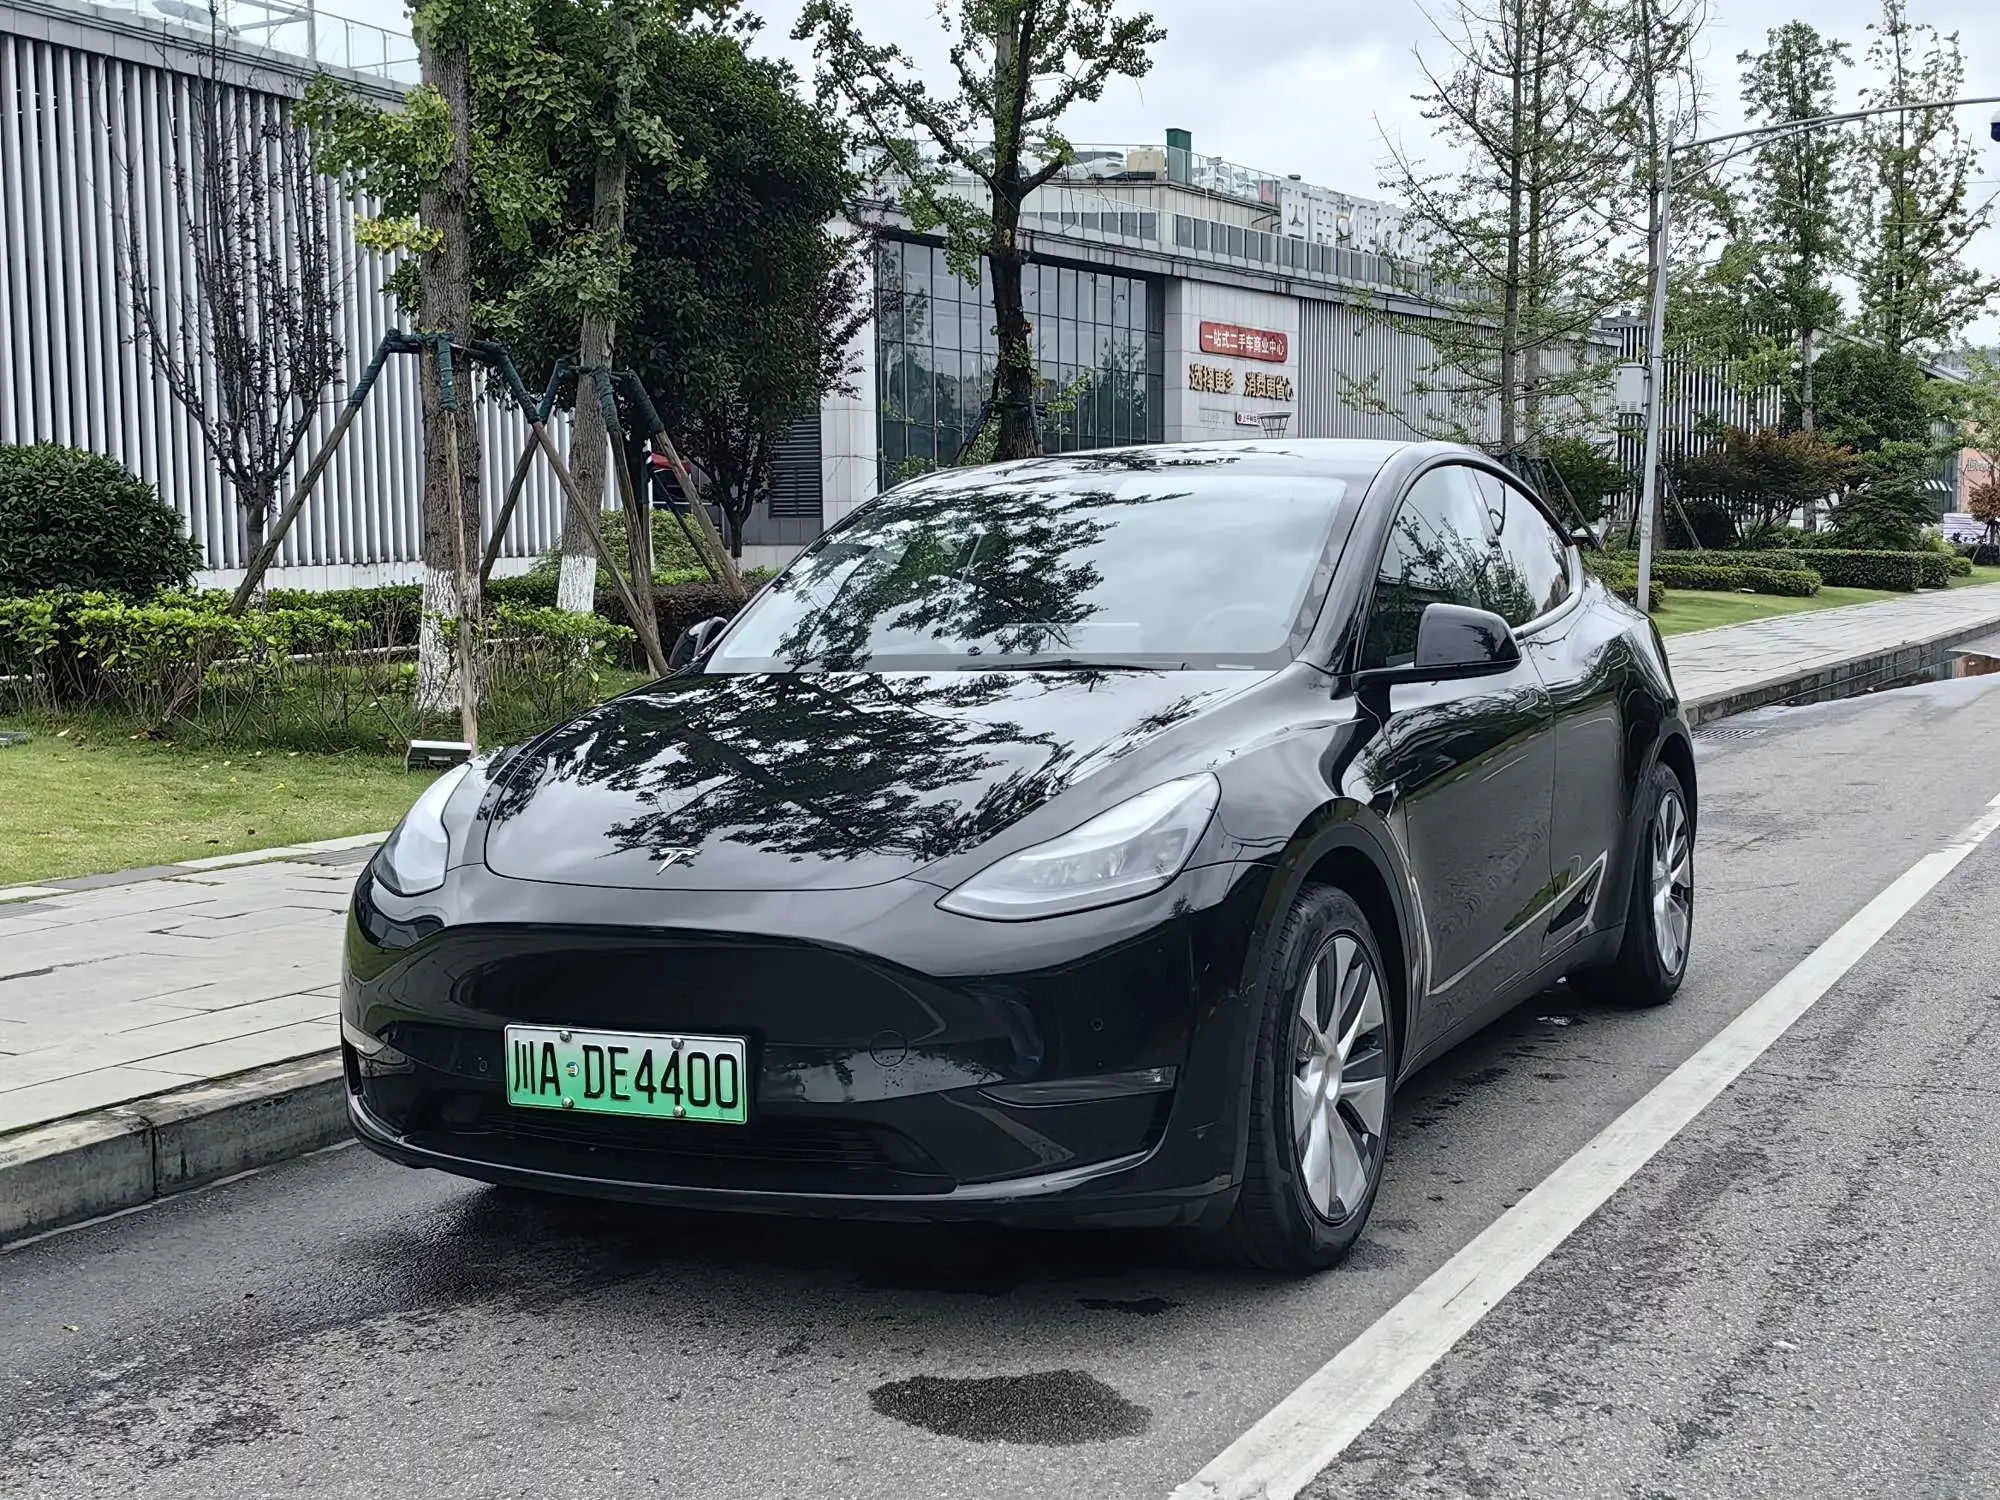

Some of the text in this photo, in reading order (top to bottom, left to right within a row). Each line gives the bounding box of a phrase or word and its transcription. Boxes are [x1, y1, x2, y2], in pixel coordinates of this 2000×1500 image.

[1205, 329, 1284, 355] 一站式二手车商业中心
